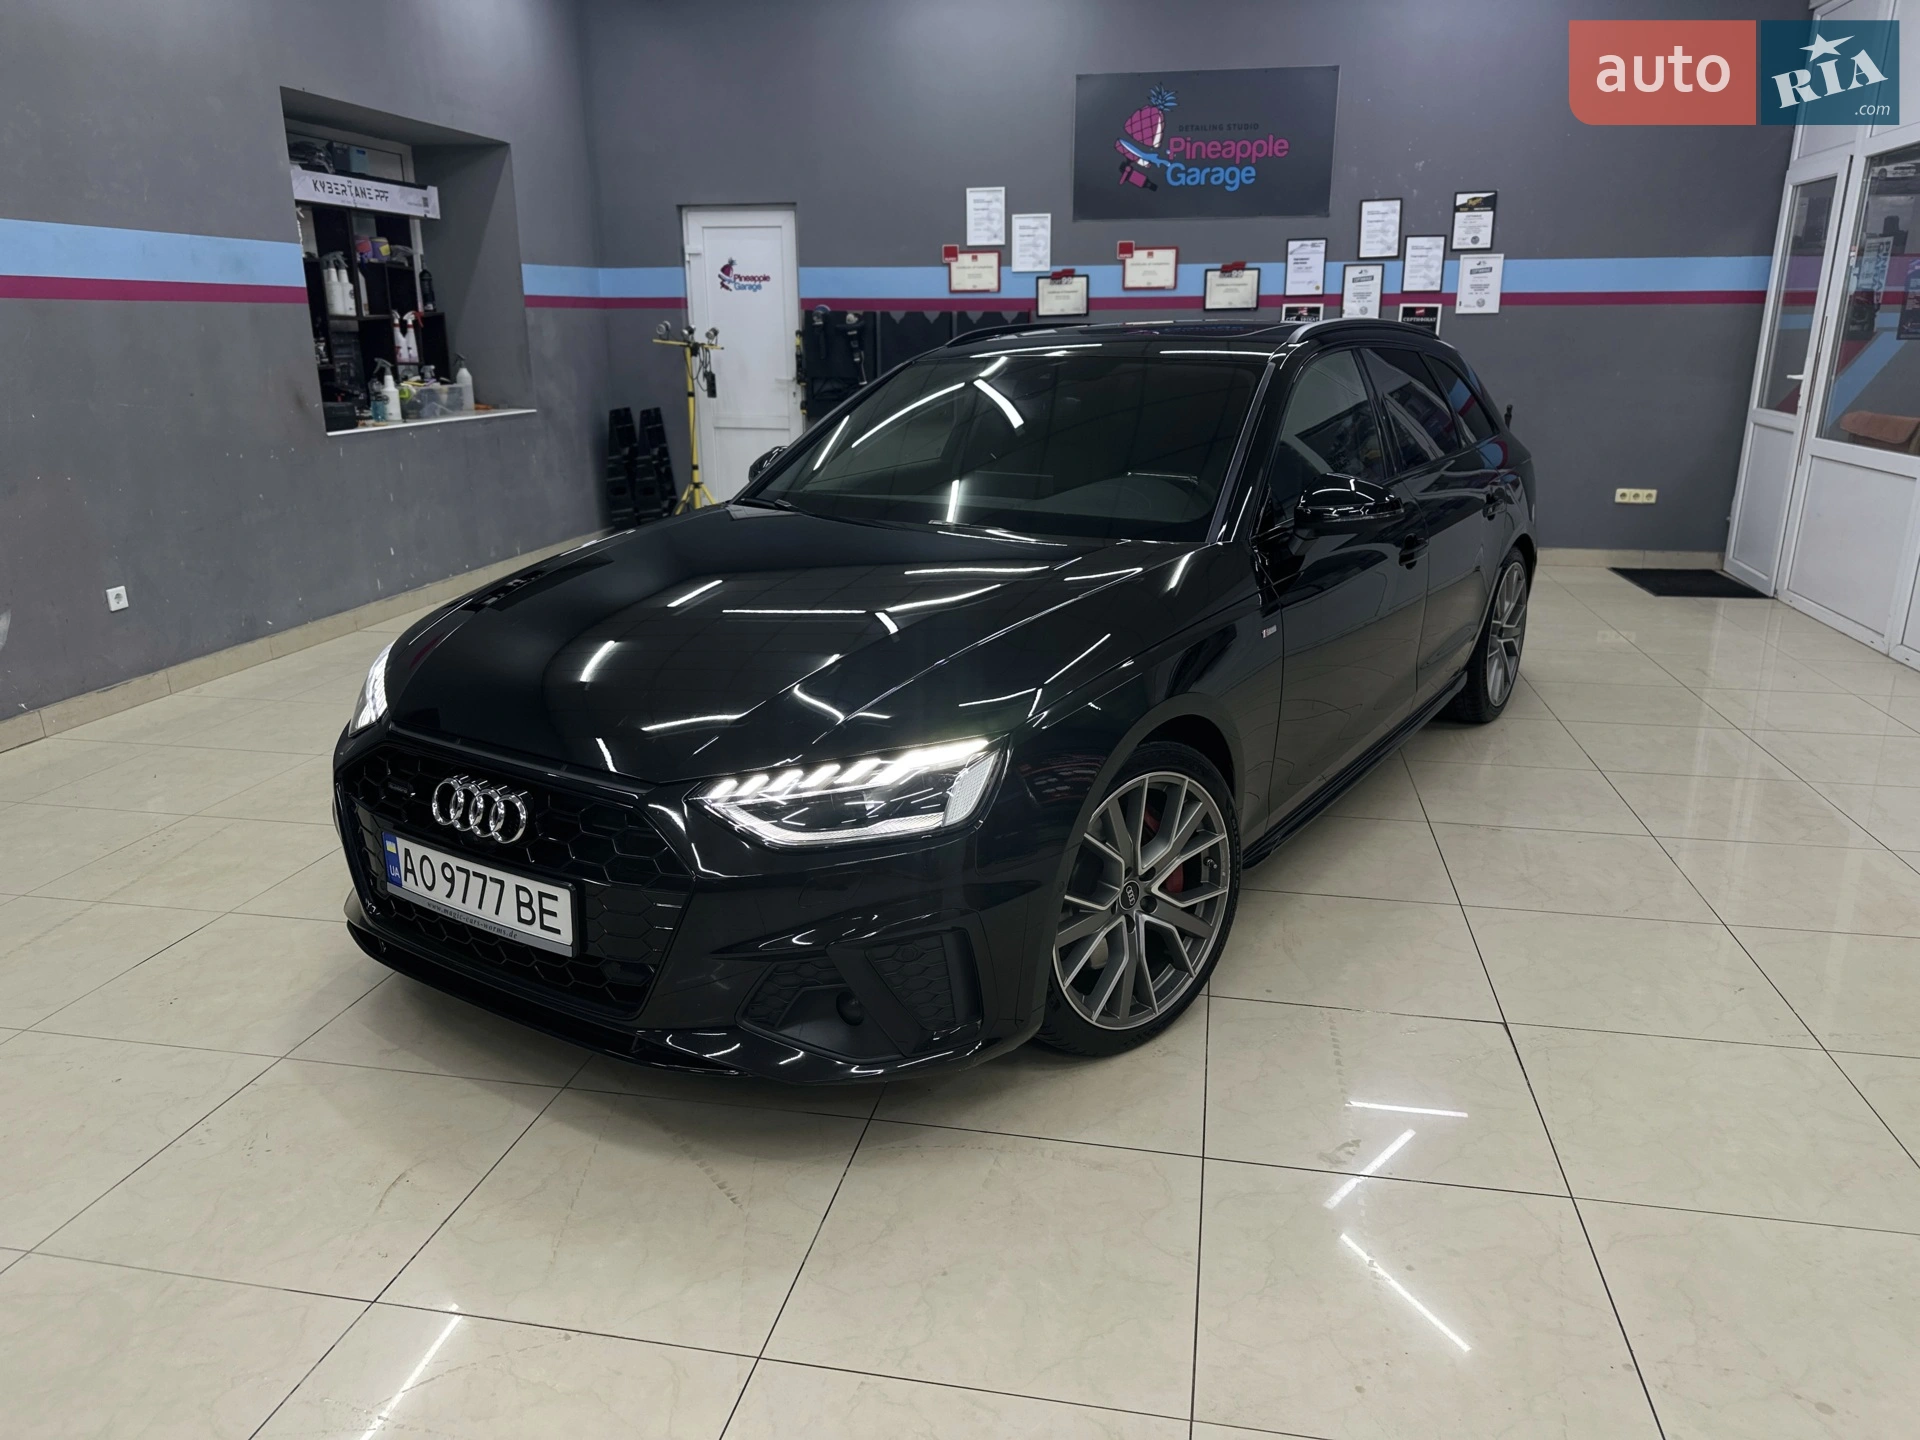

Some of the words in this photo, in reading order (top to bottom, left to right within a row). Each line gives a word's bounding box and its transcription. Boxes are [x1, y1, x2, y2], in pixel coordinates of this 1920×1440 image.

[1178, 123, 1224, 132] DETAILING
[1226, 122, 1260, 131] STUDIO
[1169, 134, 1289, 164] Pineapple
[1167, 163, 1256, 191] Garage
[733, 274, 771, 283] Pineapple
[734, 282, 762, 292] Garage
[389, 864, 401, 879] UA
[403, 848, 437, 892] AO
[441, 861, 505, 916] 9777
[515, 884, 561, 935] BE
[427, 902, 518, 939] www.magic-cars-worms.de
